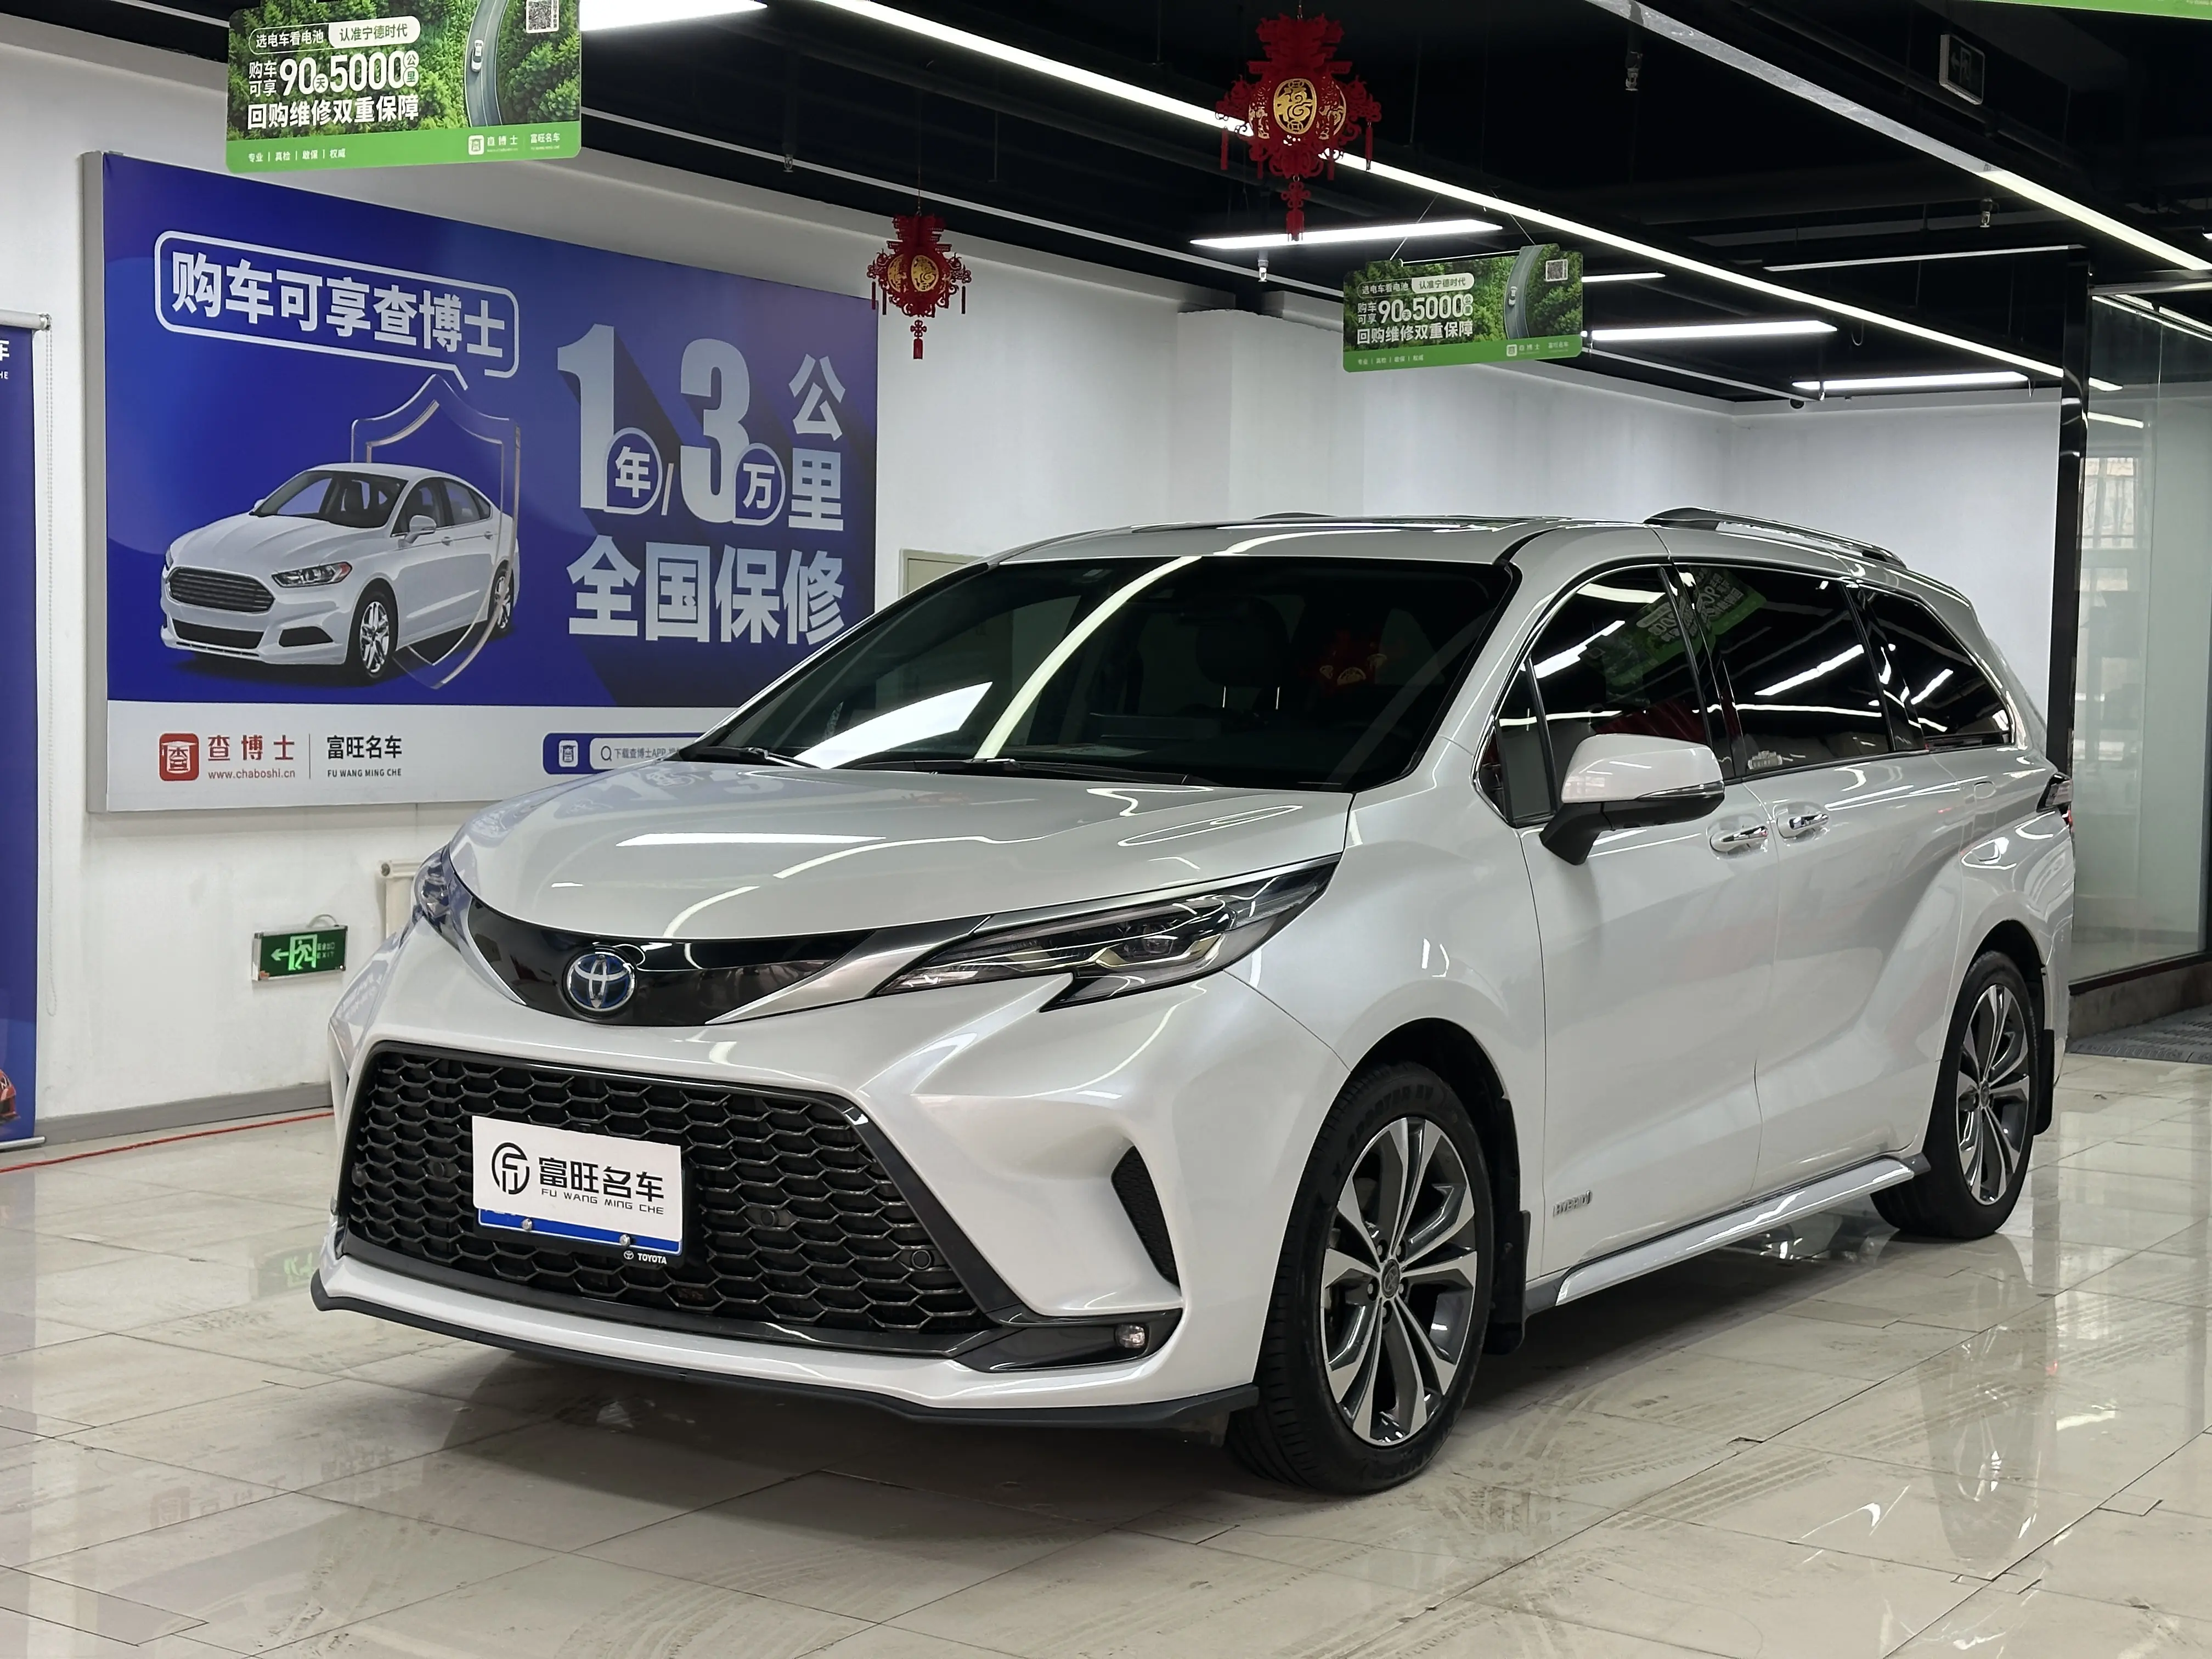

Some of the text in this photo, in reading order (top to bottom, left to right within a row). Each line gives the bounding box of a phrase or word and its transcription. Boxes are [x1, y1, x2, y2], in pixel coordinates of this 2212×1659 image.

[256, 23, 408, 48] 选电车看电池 认准宁德时代
[249, 60, 277, 78] 购车
[249, 79, 277, 97] 可享
[247, 94, 419, 130] 回购维修双重保障
[1419, 277, 1466, 290] 认准宁德时代
[171, 251, 505, 359] 购车可享查博士
[1357, 302, 1376, 314] 购车
[1357, 319, 1473, 345] 回购维修双重保障
[566, 535, 846, 646] 全国保修
[208, 734, 403, 761] 查博士 富旺名车
[208, 768, 296, 779] www.chaboshi.cn
[328, 768, 402, 778] FU WANG MING CHE
[538, 1156, 664, 1202] 富旺名车
[541, 1189, 664, 1215] FU WANG MING CHE
[637, 1252, 667, 1265] TOYOTA
